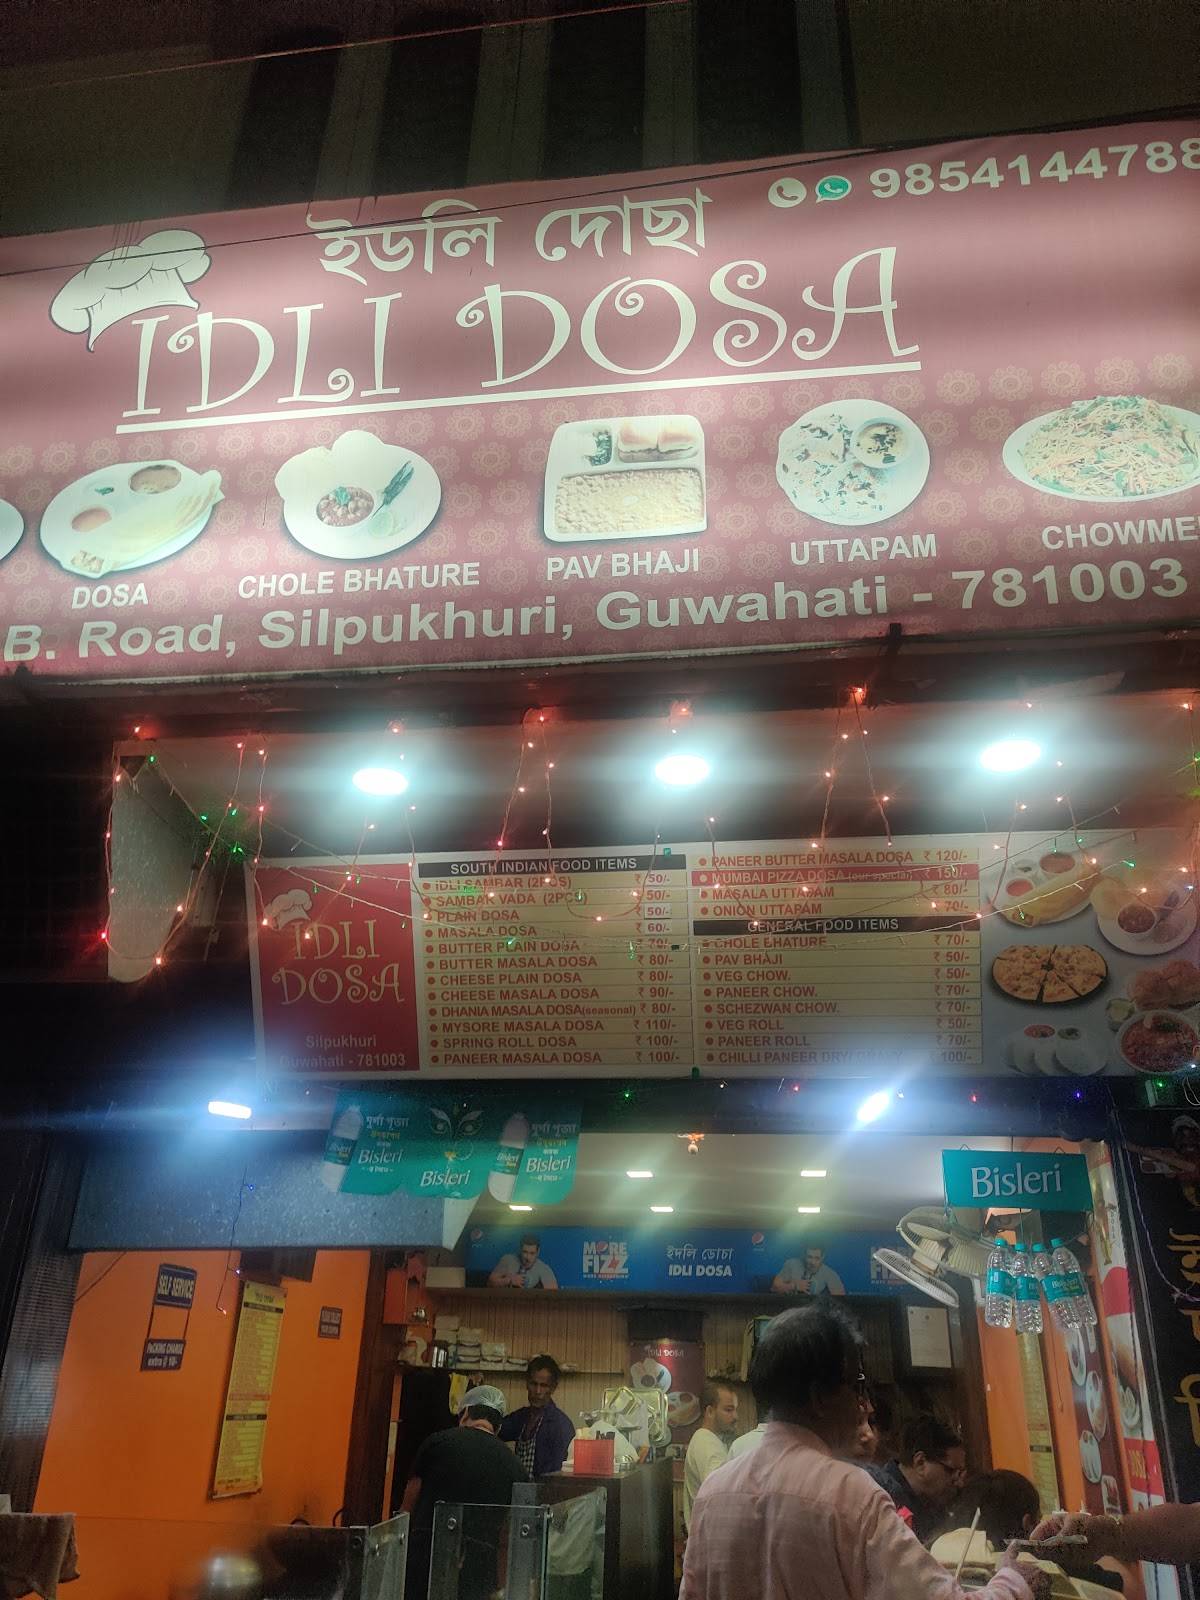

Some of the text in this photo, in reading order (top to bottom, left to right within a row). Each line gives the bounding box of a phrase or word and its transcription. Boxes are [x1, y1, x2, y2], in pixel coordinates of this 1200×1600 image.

[870, 137, 1200, 198] 9854144788
[307, 187, 712, 285] ইডলি দোছা
[122, 246, 920, 419] IDLI DOSA
[1041, 515, 1200, 550] CHOWME
[790, 533, 938, 567] UTTAPAM
[546, 549, 700, 582] PAV BHAJI
[238, 561, 480, 600] CHOLE BHATURE
[71, 584, 149, 611] DOSA
[78, 614, 236, 658] Road,
[258, 594, 573, 654] Silpukhuri,
[596, 575, 888, 630] Guwahati
[950, 557, 1188, 611] 781003
[451, 858, 637, 875] SOUTH INDIAN FOOD ITEMS
[712, 856, 761, 867] PANEER
[764, 854, 816, 866] BUTTER
[819, 853, 874, 865] MASALA
[876, 852, 913, 863] DOSA
[936, 851, 968, 862] 120/-
[648, 874, 670, 883] 50/-
[712, 872, 764, 883] MUMBAI
[767, 871, 804, 882] PIZZA
[808, 870, 845, 882] DOSA
[499, 894, 536, 905] VADA
[647, 890, 671, 900] 50/-
[712, 888, 768, 899] MASALA
[944, 883, 968, 895] 80/-
[437, 906, 670, 922] PLAIN DOSA 50/-
[713, 901, 968, 917] ONION UTTAPAM 70/-
[438, 922, 670, 938] MASALA DOSA 60/-
[747, 918, 899, 933] GENERAL FOOD ITEMS
[292, 920, 381, 960] IDLI
[439, 943, 492, 954] BUTTER
[497, 941, 536, 952] PLAIN
[541, 941, 580, 951] DOSA
[946, 934, 970, 945] 70/-
[439, 960, 493, 970] BUTTER
[497, 959, 555, 969] MASALA
[558, 957, 598, 968] DOSA
[650, 955, 674, 965] 80/-
[715, 954, 739, 966] PAV
[744, 953, 782, 965] BHAJI
[440, 975, 494, 985] CHEESE
[499, 974, 539, 984] PLAIN
[543, 973, 582, 984] DOSA
[650, 971, 674, 981] 80/-
[716, 968, 970, 981] VEG CHOW. 50/-
[272, 963, 405, 1005] DOSA
[716, 984, 970, 998] PANEER CHOW. 70/-
[441, 991, 494, 1001] CHEESE
[500, 990, 555, 1000] MASALA
[560, 989, 599, 998] DOSA
[650, 987, 674, 997] 90/-
[442, 1007, 488, 1017] DHANIA
[492, 1006, 544, 1016] MASALA
[652, 1003, 676, 1013] 80/-
[717, 1001, 971, 1014] SCHEZWAN CHOW. 70/-
[443, 1022, 499, 1033] MYSORE
[504, 1021, 561, 1032] MASALA
[566, 1020, 604, 1031] DOSA
[646, 1019, 676, 1029] 110/-
[717, 1019, 745, 1030] VEG
[750, 1019, 784, 1030] ROLL
[306, 1034, 376, 1050] Silpukhuri
[444, 1038, 493, 1048] SPRING
[498, 1037, 534, 1047] ROLL
[538, 1037, 577, 1047] DOSA
[647, 1035, 678, 1046] 100/-
[718, 1036, 771, 1047] PANEER
[775, 1035, 810, 1046] ROLL
[357, 1054, 406, 1066] 781003
[444, 1054, 497, 1065] PANEER
[502, 1053, 559, 1064] MASALA
[563, 1052, 602, 1063] DOSA
[649, 1051, 680, 1061] 100/-
[719, 1052, 761, 1063] CHILLI
[764, 1052, 817, 1063] PANEER
[941, 1050, 973, 1061] 100/-
[358, 1148, 402, 1164] Bisleri
[526, 1156, 571, 1172] Bisleri
[420, 1170, 470, 1187] Bisleri
[971, 1163, 1062, 1198] Bisleri
[582, 1255, 628, 1274] FIZZ
[668, 1265, 732, 1276] IDLI DOSA
[158, 1275, 194, 1299] SELF SERVICE
